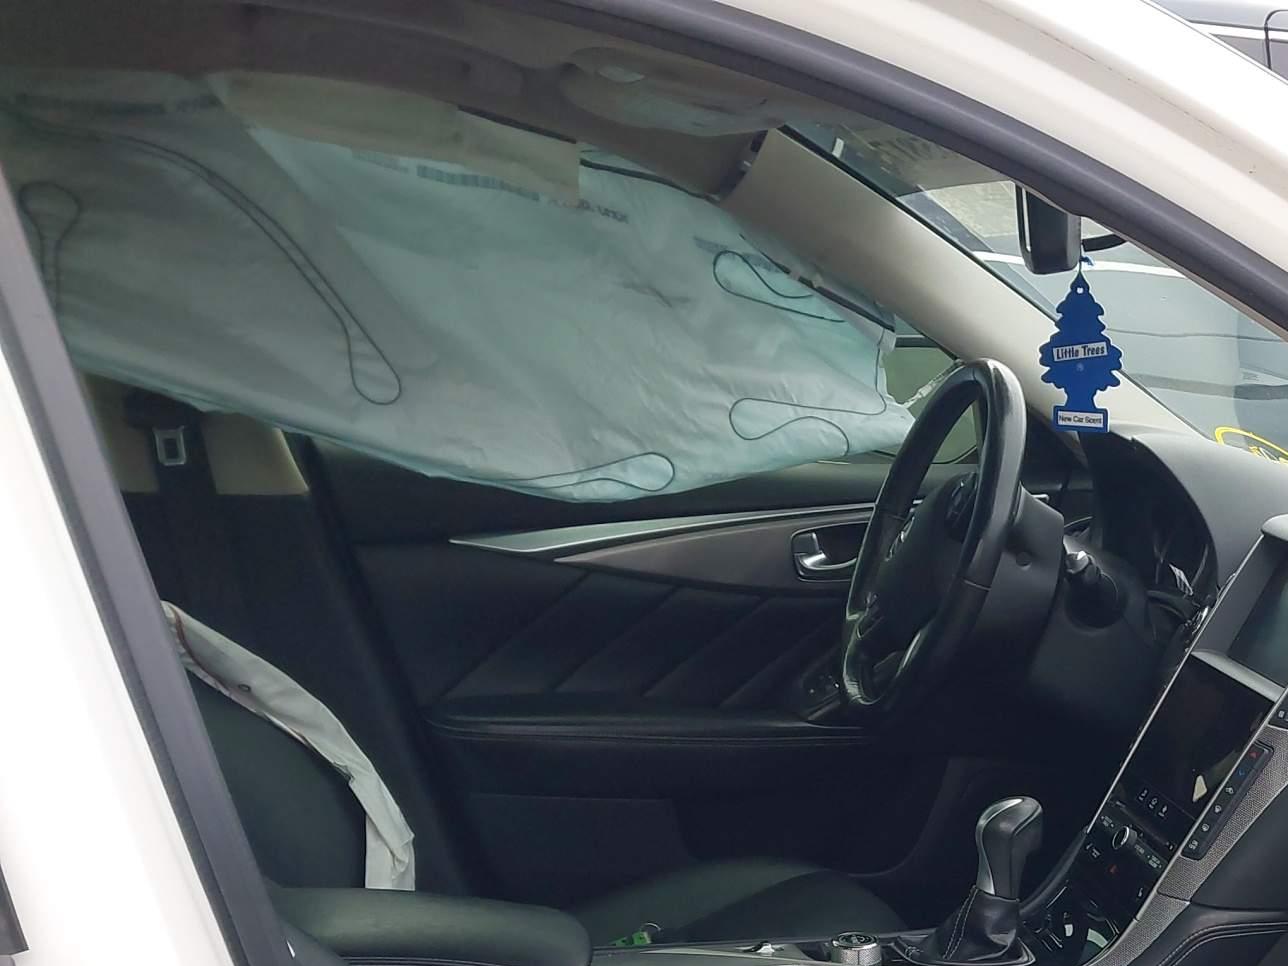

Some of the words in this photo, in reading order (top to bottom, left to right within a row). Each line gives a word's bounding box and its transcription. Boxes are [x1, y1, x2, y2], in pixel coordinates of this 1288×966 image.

[1056, 347, 1080, 360] Little
[1081, 345, 1105, 357] Trees
[1059, 414, 1072, 422] New
[1073, 415, 1084, 423] Car
[1085, 416, 1103, 424] Scent
